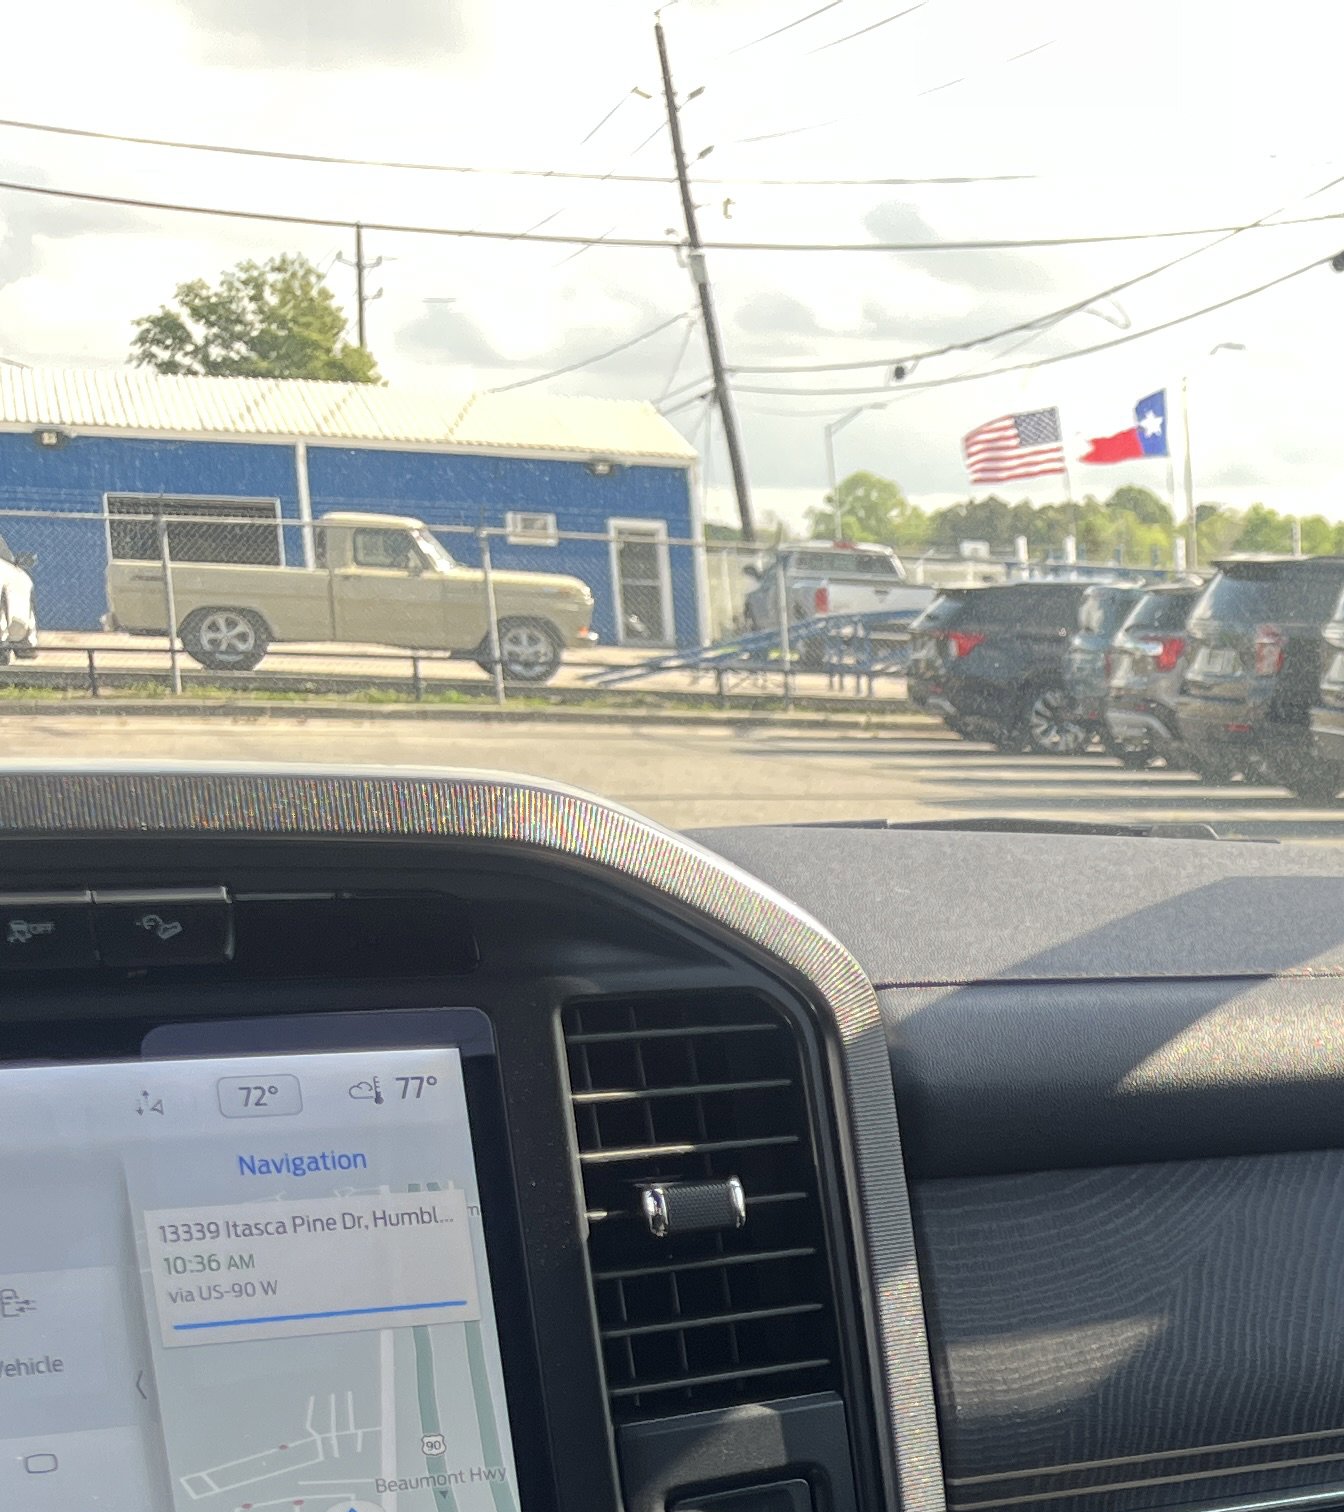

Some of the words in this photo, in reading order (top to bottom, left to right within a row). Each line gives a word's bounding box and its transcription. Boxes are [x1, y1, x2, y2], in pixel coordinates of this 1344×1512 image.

[238, 1084, 279, 1109] 72°
[396, 1074, 438, 1100] 77°
[238, 1150, 368, 1177] Navigation
[158, 1221, 220, 1244] 13339
[225, 1218, 288, 1239] Itasca
[292, 1214, 338, 1234] Pine
[342, 1211, 369, 1231] Dr,
[163, 1253, 221, 1275] 10:36
[227, 1253, 255, 1271] AM
[168, 1286, 195, 1304] via
[200, 1281, 256, 1301] US-90
[260, 1279, 278, 1296] W
[425, 1440, 442, 1451] 90
[375, 1469, 465, 1494] Beaumont
[470, 1466, 507, 1482] Hwy
